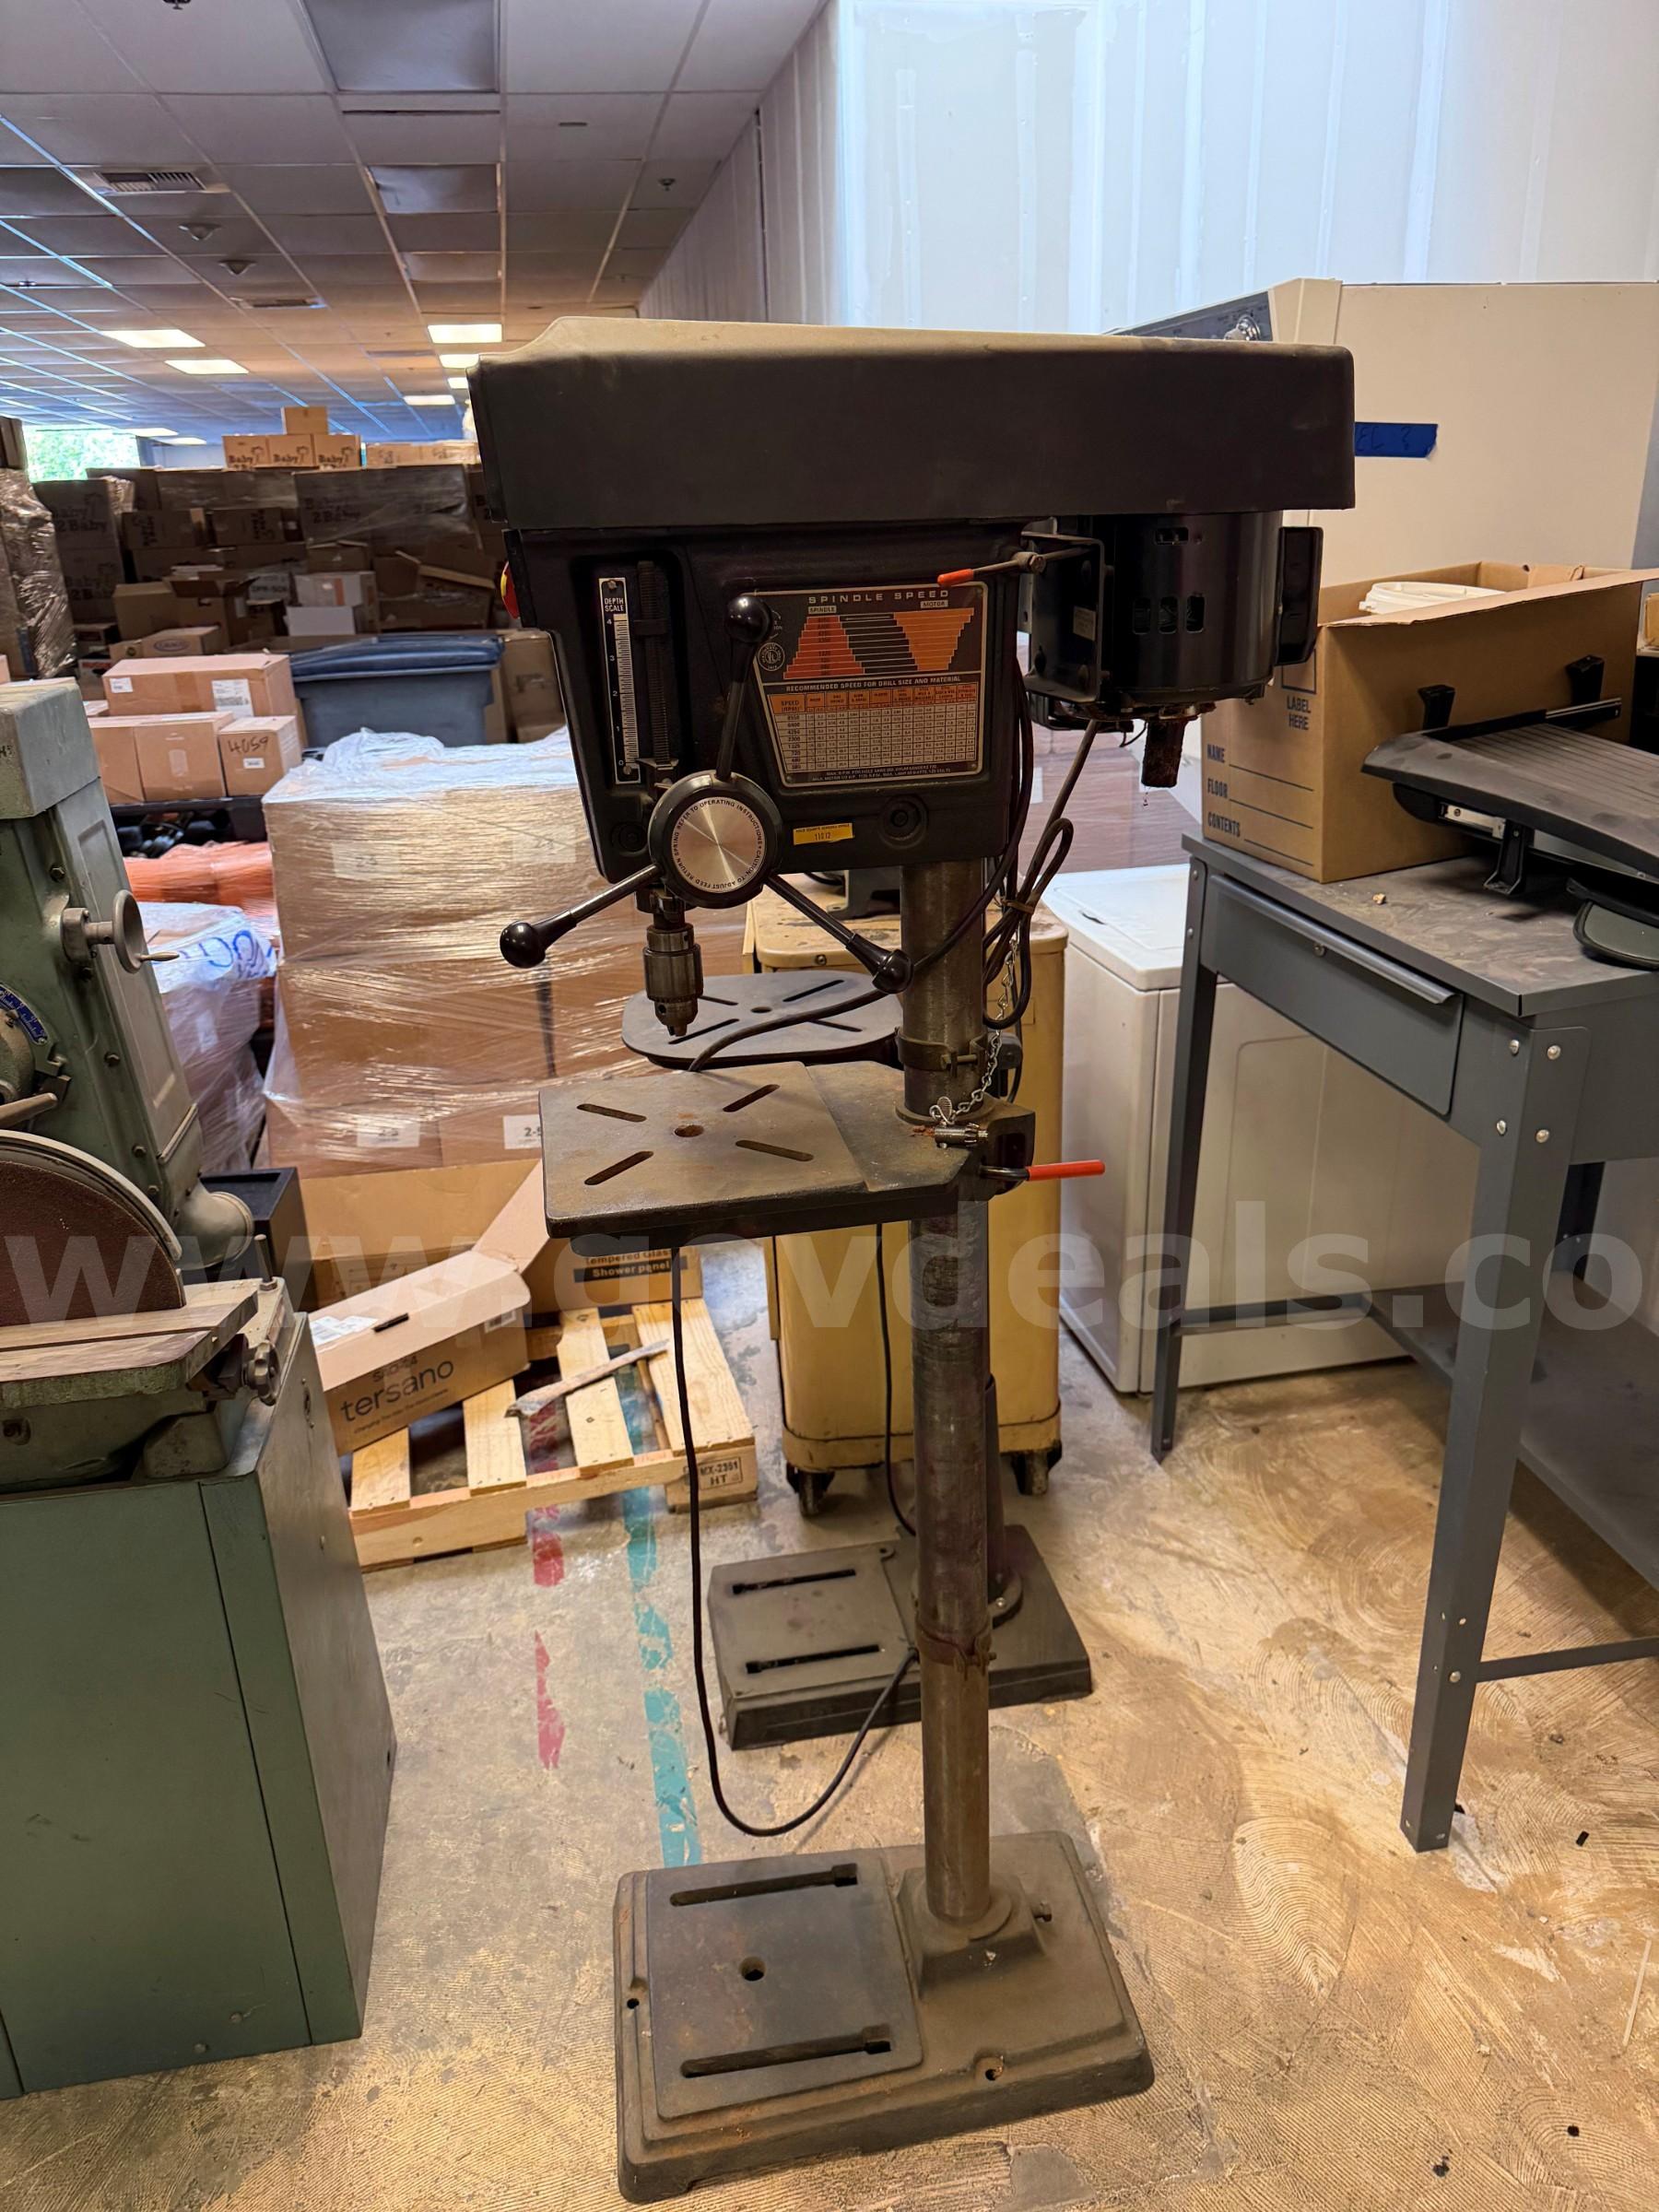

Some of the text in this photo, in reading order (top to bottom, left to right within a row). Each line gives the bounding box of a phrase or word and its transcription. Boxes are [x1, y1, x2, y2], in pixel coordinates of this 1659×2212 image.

[808, 591, 948, 604] SPINDLE SPEED
[786, 683, 839, 692] RECOMMENDED
[1287, 696, 1311, 713] LABEL
[1288, 713, 1309, 730] HERE
[1206, 744, 1225, 763] NAME
[1207, 778, 1228, 798] FLOOR
[1207, 811, 1241, 838] CONTENTS
[677, 857, 694, 880] RETURN
[690, 806, 699, 814] TO
[700, 799, 735, 807] OPERATING
[736, 805, 762, 844] INSTRUCTIONS
[592, 1260, 670, 1277] Shower panel
[340, 1359, 454, 1422] tersano
[710, 1475, 726, 1486] HT
